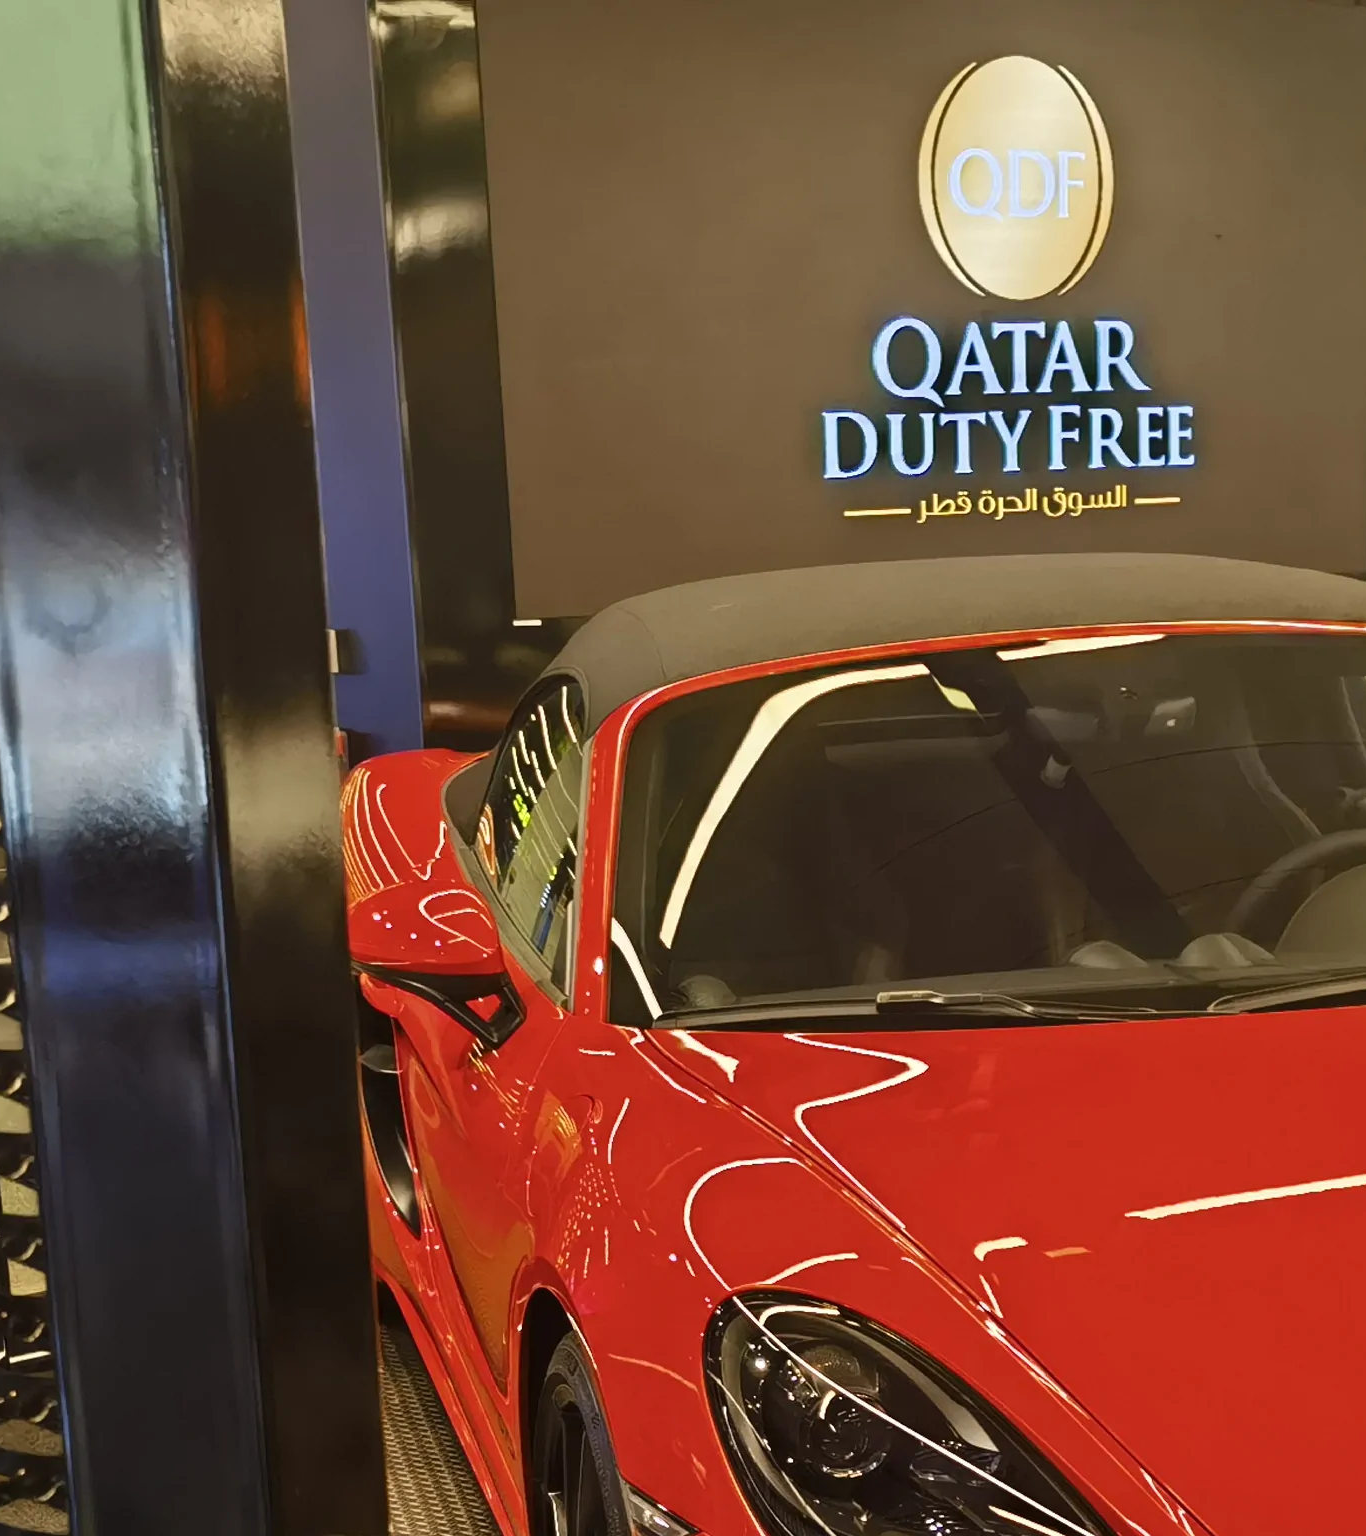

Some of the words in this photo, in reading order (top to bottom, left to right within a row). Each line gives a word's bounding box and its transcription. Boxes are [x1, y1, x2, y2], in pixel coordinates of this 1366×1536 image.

[946, 147, 1086, 220] QDF
[872, 315, 1152, 409] QATAR
[821, 409, 1033, 480] DUTY
[1047, 404, 1196, 471] FREE
[916, 490, 973, 524] قطر
[977, 487, 1038, 521] الحرة
[1042, 484, 1128, 518] السوق
